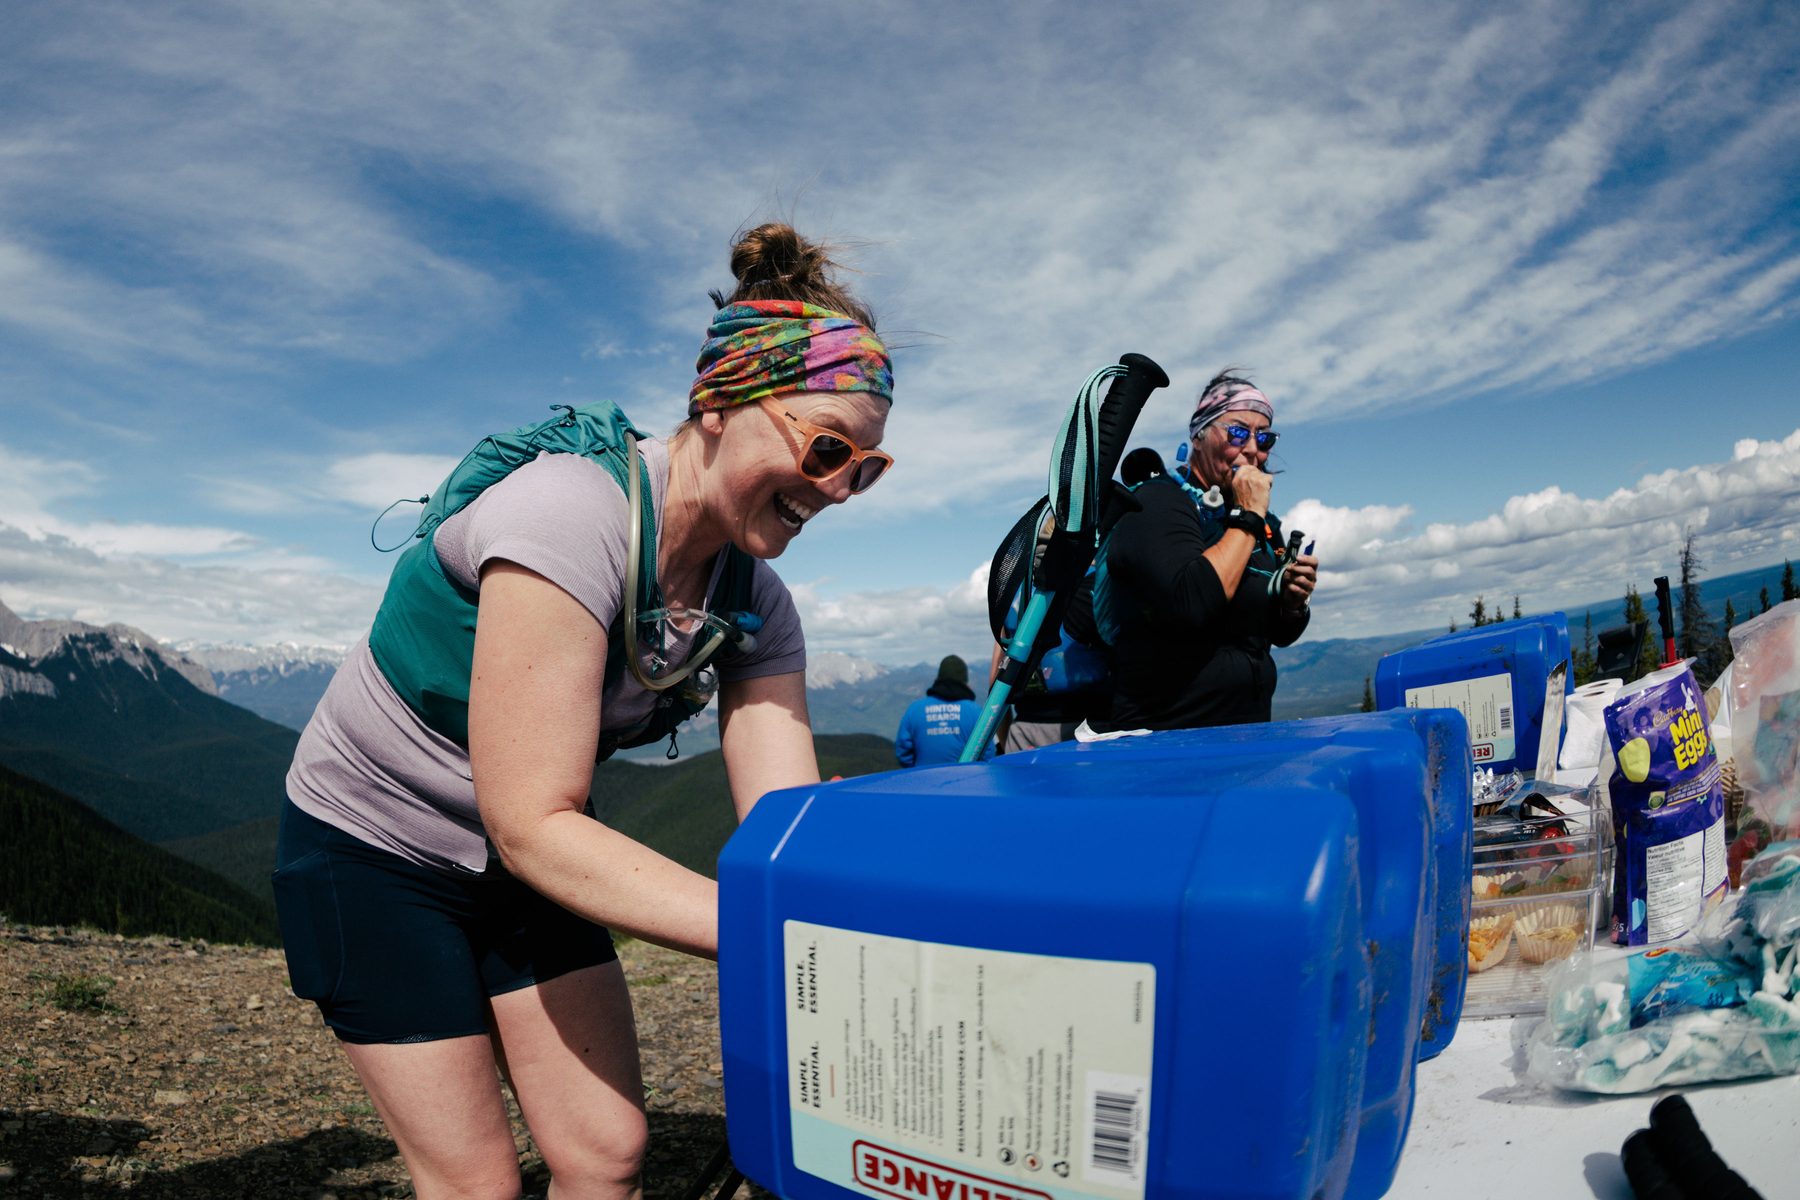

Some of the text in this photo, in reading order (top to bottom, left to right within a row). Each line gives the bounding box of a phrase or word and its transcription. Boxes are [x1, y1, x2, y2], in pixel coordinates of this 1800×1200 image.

[925, 704, 961, 713] HINTON
[926, 713, 960, 721] SEARCH
[1669, 703, 1704, 746] Mini
[927, 727, 960, 735] RESCUE
[1674, 729, 1707, 771] Eggs
